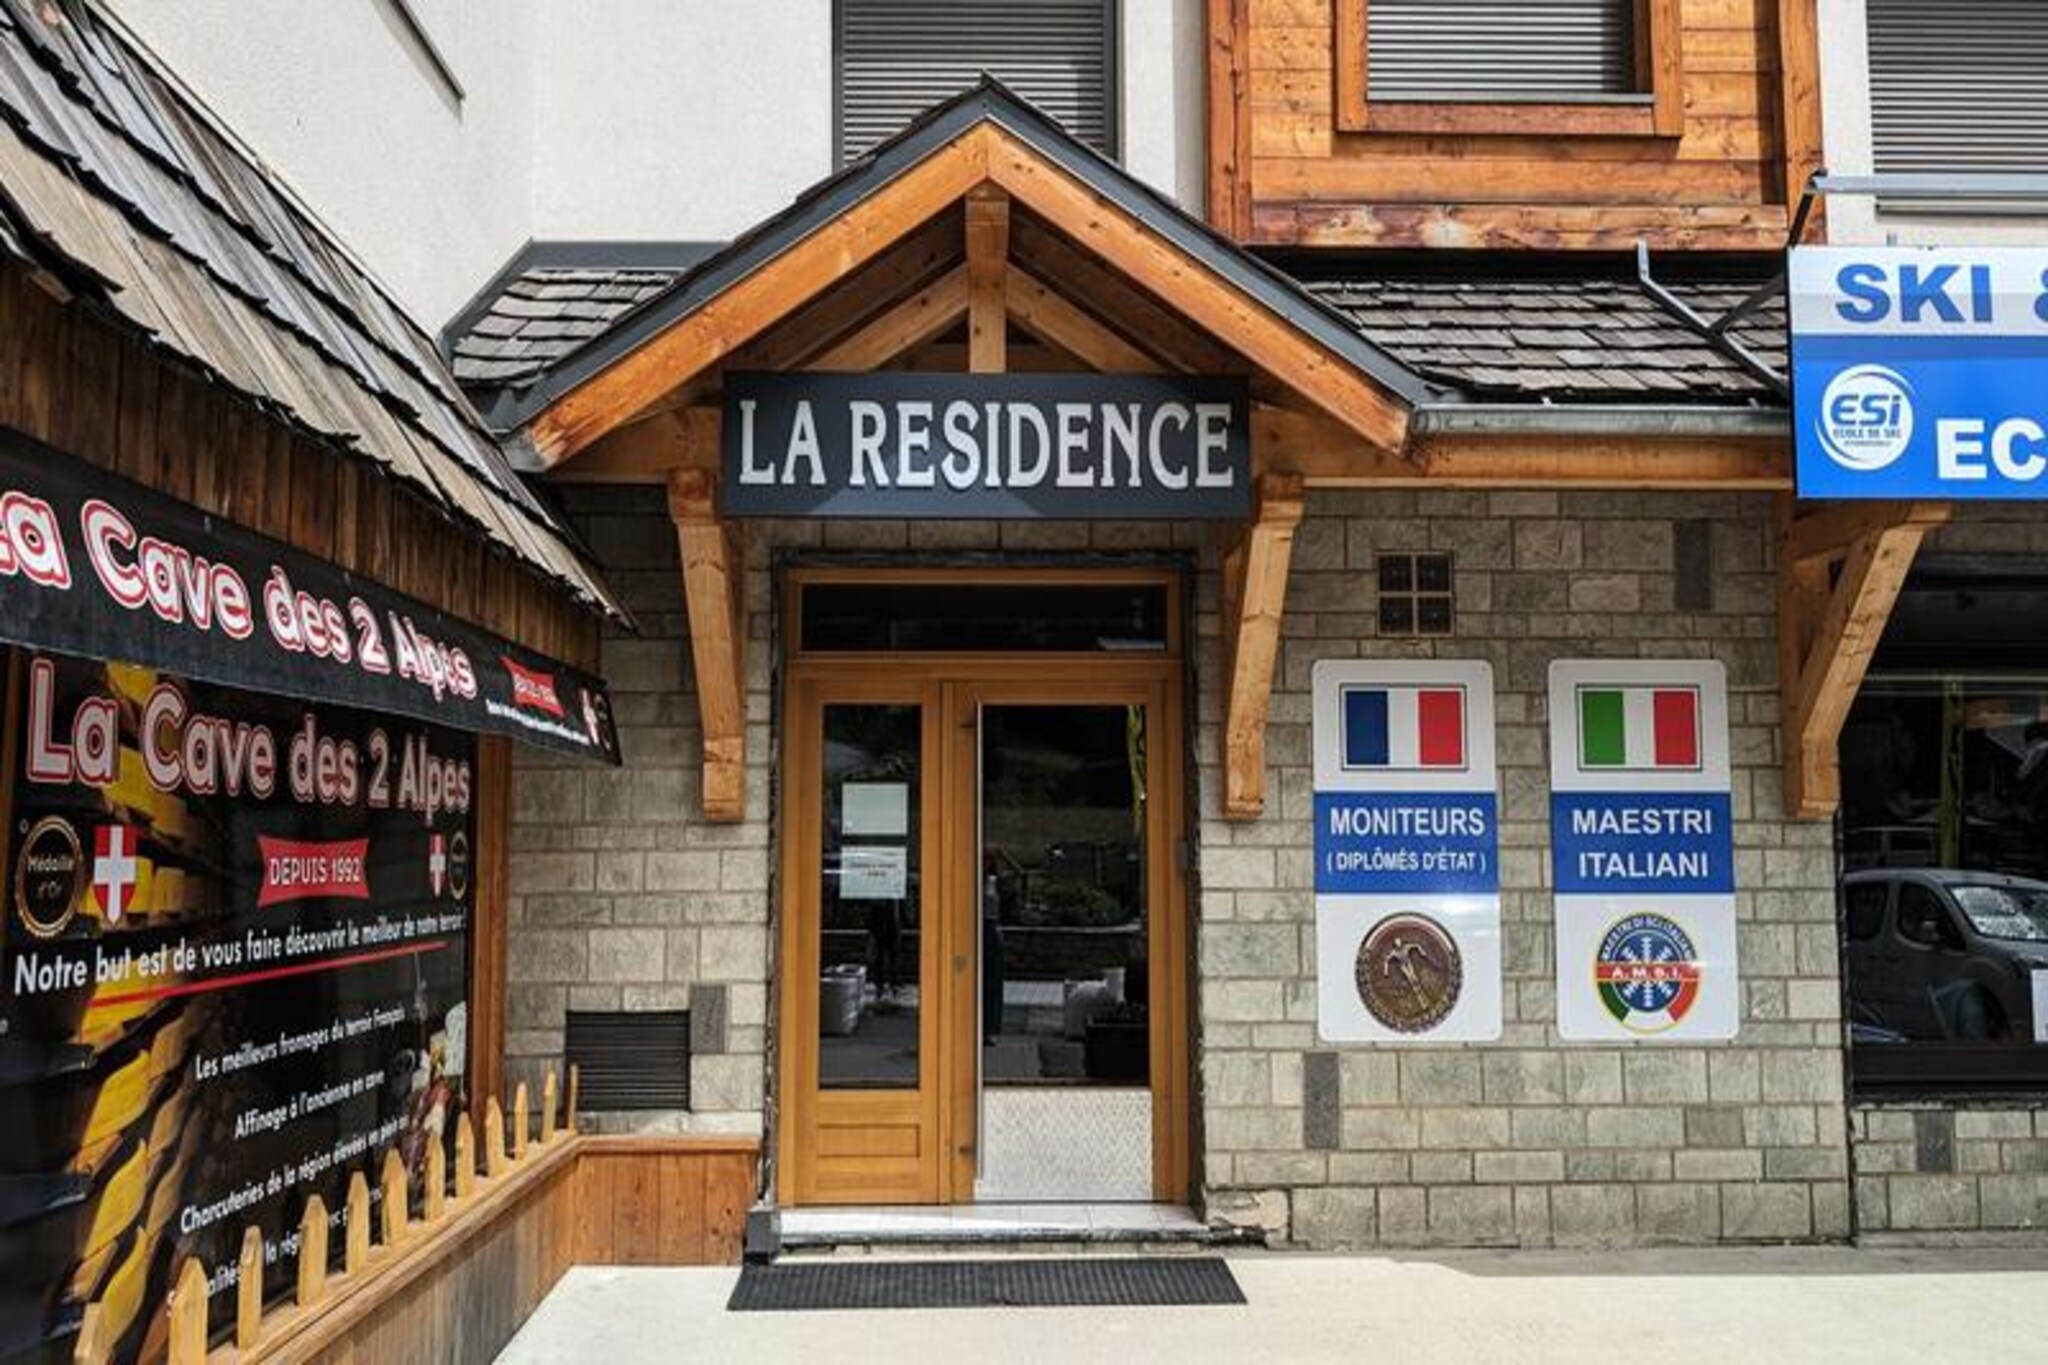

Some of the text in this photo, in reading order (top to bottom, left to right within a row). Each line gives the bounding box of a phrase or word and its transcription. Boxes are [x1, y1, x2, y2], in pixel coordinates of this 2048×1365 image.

[1835, 263, 1993, 323] SKI
[739, 400, 1234, 490] LA RESIDENCE
[0, 491, 478, 702] a Cave des 2 Alpes
[26, 657, 470, 827] La Cave des 2 Alpes
[1330, 807, 1485, 836] MONITEURS
[1572, 809, 1712, 835] MAESTRI
[269, 856, 361, 885] DEPUIS 1992
[1579, 852, 1709, 878] ITALIANI
[14, 952, 88, 996] Notre
[95, 946, 131, 983] but
[137, 944, 167, 976] est
[172, 937, 196, 971] de
[201, 940, 241, 968] vous
[246, 928, 281, 964] faire
[285, 920, 347, 957] découvrir
[347, 915, 359, 945] le
[361, 914, 402, 944] meilleur
[403, 912, 416, 937] de
[195, 1054, 218, 1081] Les
[221, 1041, 278, 1073] meilleurs
[279, 1031, 330, 1054] fromages
[331, 1018, 344, 1041] du
[345, 1011, 373, 1036] terroir
[234, 1106, 288, 1141] Affinage
[289, 1096, 299, 1120] à
[301, 1083, 350, 1115] l'ancienne
[181, 1181, 265, 1234] Charcuteries
[266, 1170, 283, 1196] de
[284, 1164, 296, 1187] la
[298, 1151, 331, 1181] région
